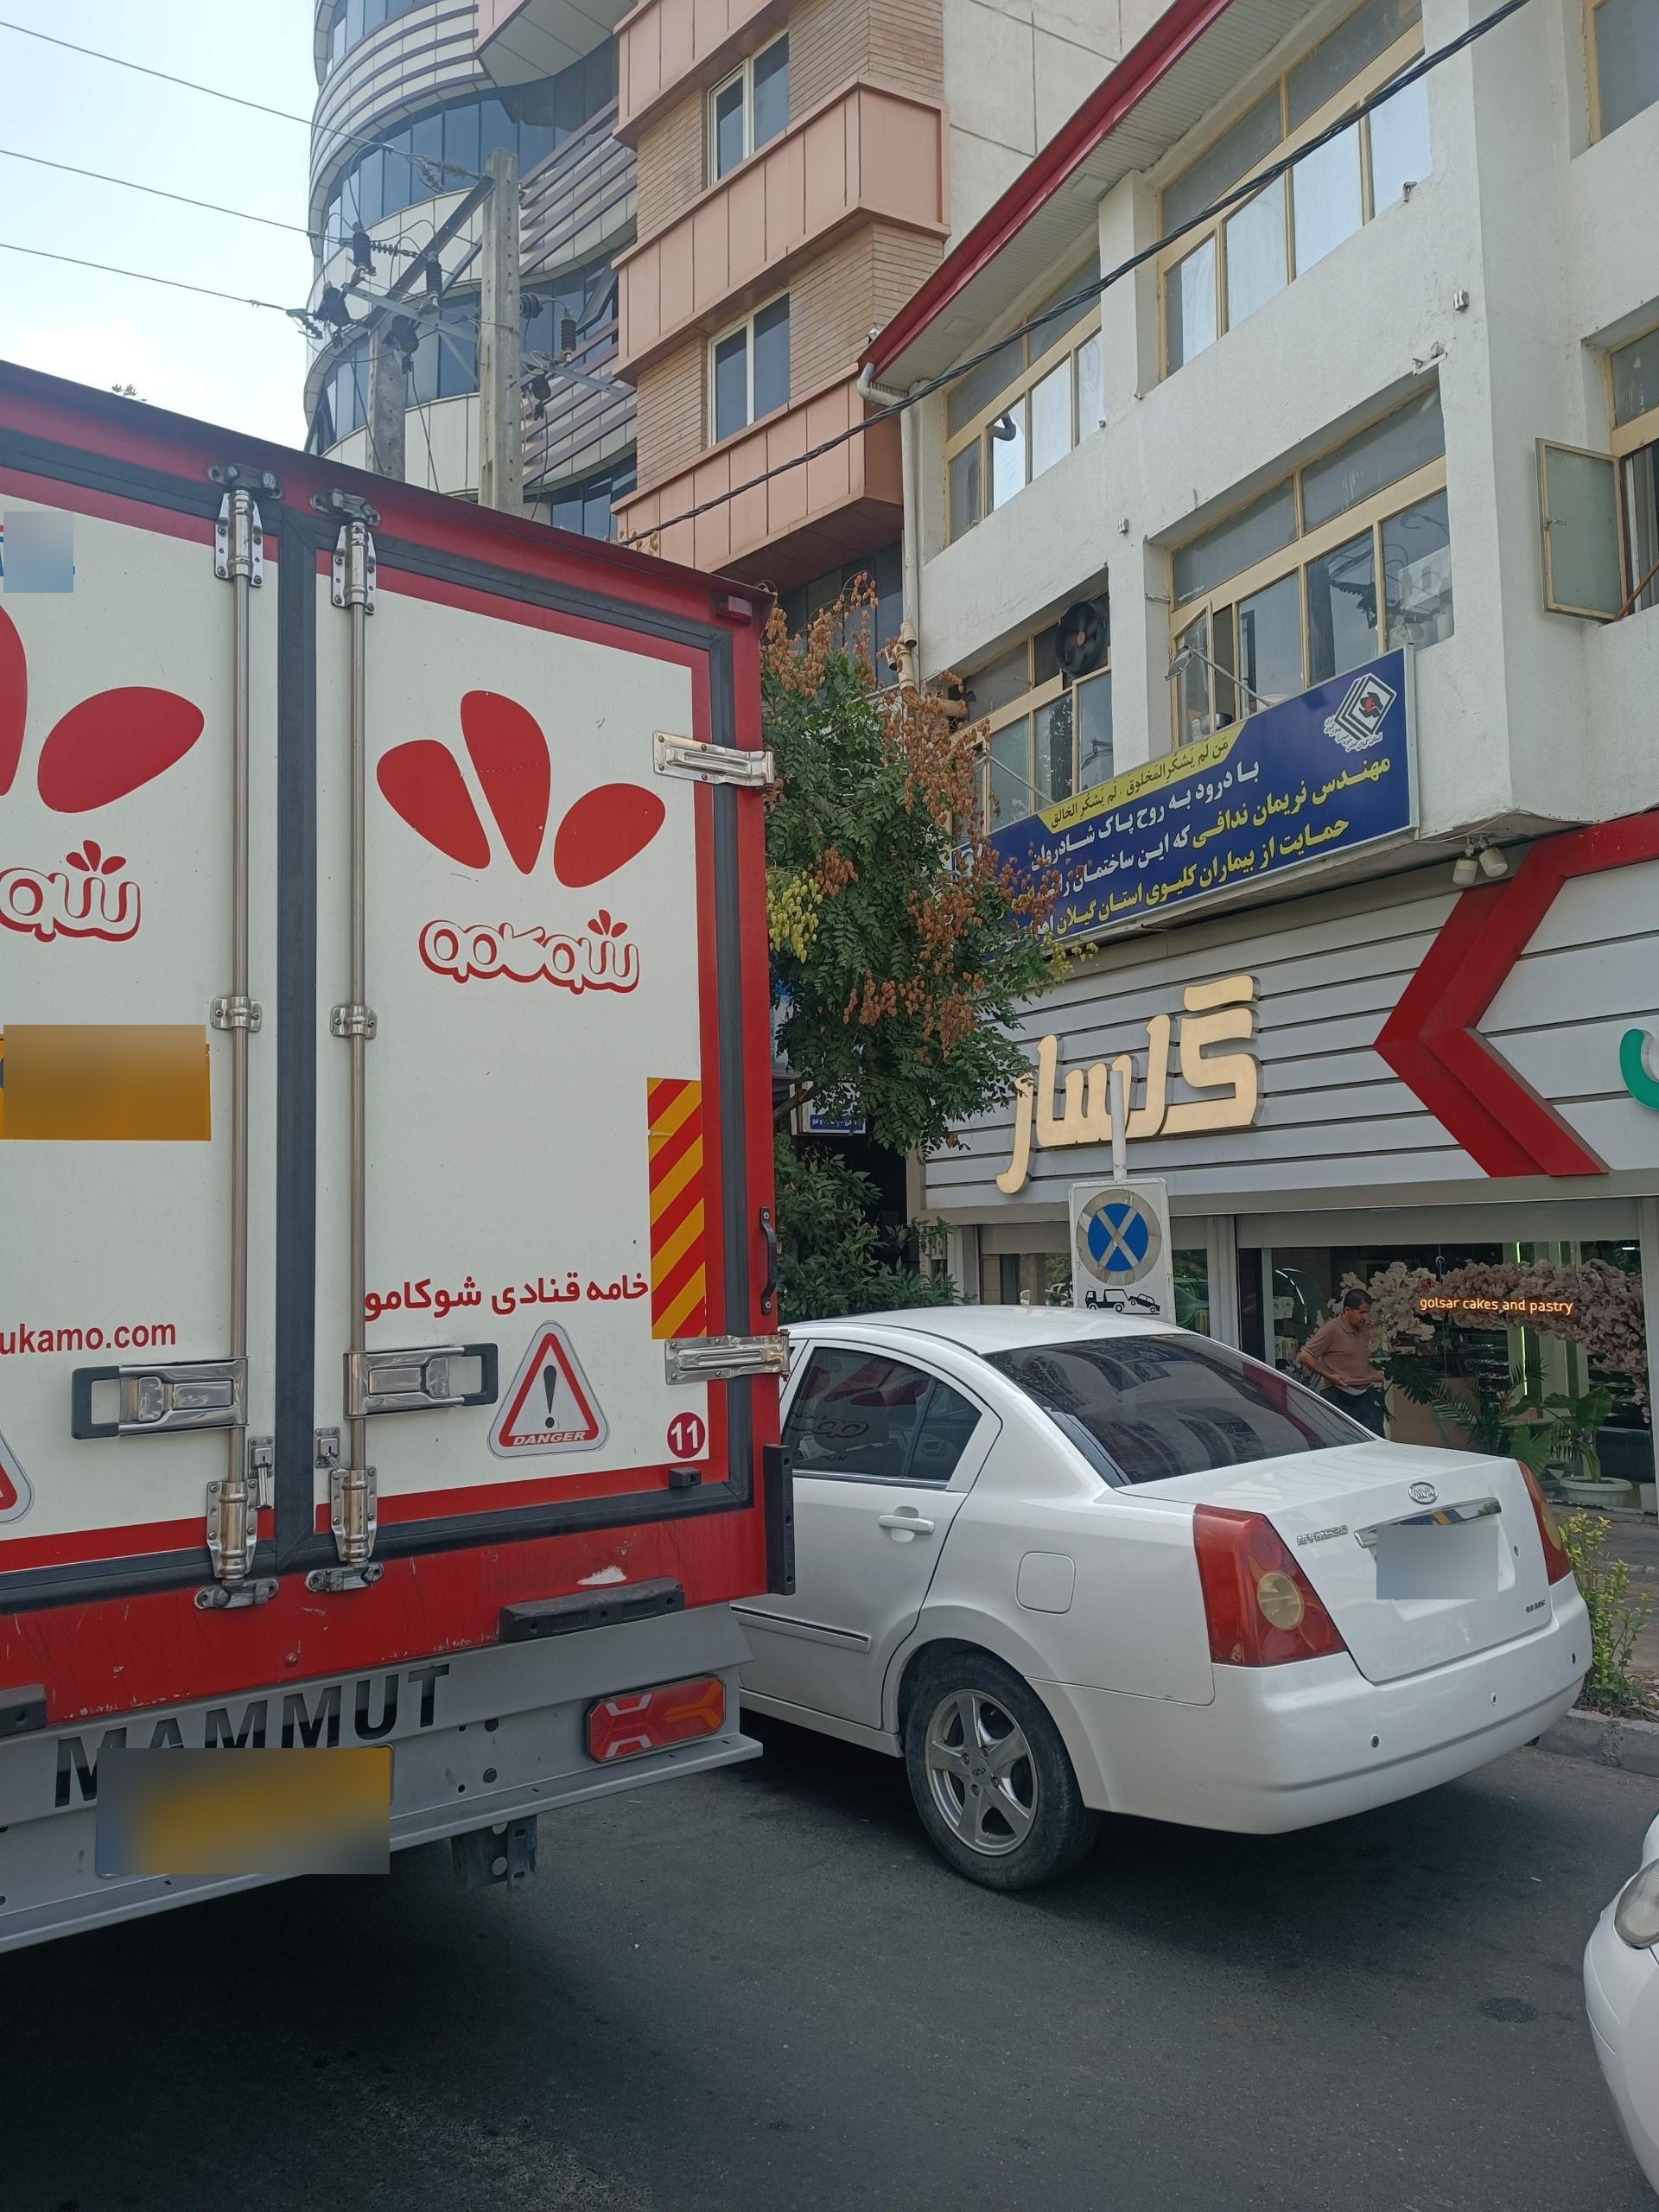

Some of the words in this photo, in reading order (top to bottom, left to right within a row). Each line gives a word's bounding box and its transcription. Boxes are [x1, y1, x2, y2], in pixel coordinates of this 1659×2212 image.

[1194, 770, 1233, 804] درود
[1236, 759, 1261, 784] با
[1312, 755, 1391, 805] مهندس
[1168, 787, 1192, 810] به
[1252, 779, 1307, 827] نریمان
[1098, 813, 1135, 840] پاک
[1135, 804, 1166, 830] روح
[1136, 831, 1170, 869] این
[1172, 823, 1192, 849] که
[1259, 836, 1275, 870] از
[1279, 817, 1350, 856] حمایت
[1072, 849, 1135, 893] ساختمان
[1145, 863, 1198, 906] کلیوی
[1198, 848, 1255, 888] بیماران
[1056, 899, 1097, 935] گیلان
[1097, 883, 1143, 922] استان
[365, 1275, 482, 1322] شوکامو
[491, 1272, 581, 1315] قنادی
[586, 1272, 650, 1301] خامه
[1420, 1297, 1461, 1312] golsar
[1462, 1298, 1499, 1311] cakes
[1502, 1299, 1526, 1311] and
[1529, 1300, 1573, 1316] pastry
[512, 1431, 587, 1446] DANGER
[671, 1420, 699, 1452] 11
